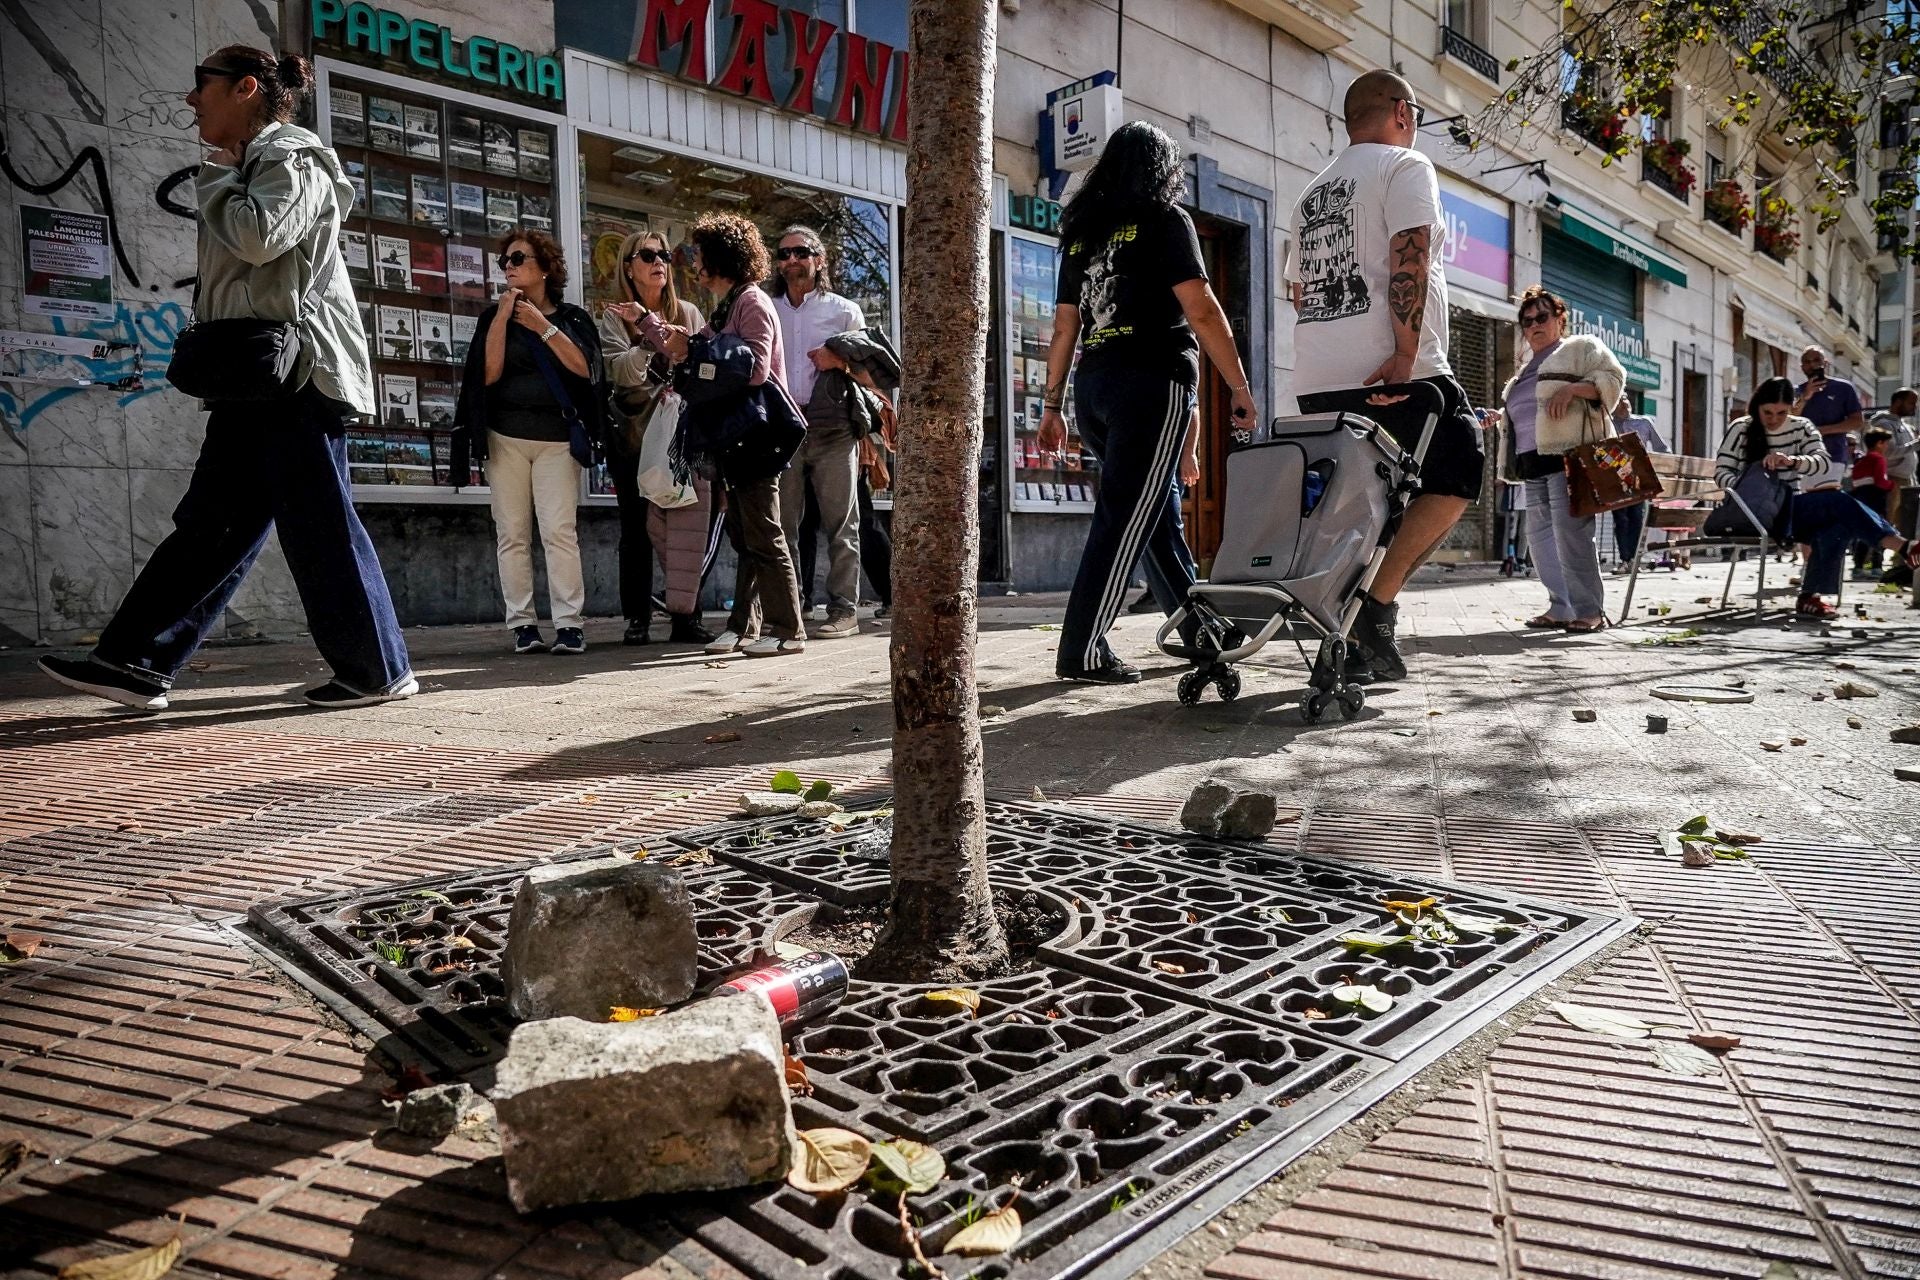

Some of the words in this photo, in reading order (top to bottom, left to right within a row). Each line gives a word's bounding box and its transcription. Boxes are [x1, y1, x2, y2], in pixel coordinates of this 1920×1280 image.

[313, 0, 566, 101] PAPELERIA
[54, 225, 102, 238] LANGILEOK
[1612, 240, 1649, 271] Herbolario
[26, 339, 56, 348] GARA
[1572, 308, 1643, 359] Herbolario
